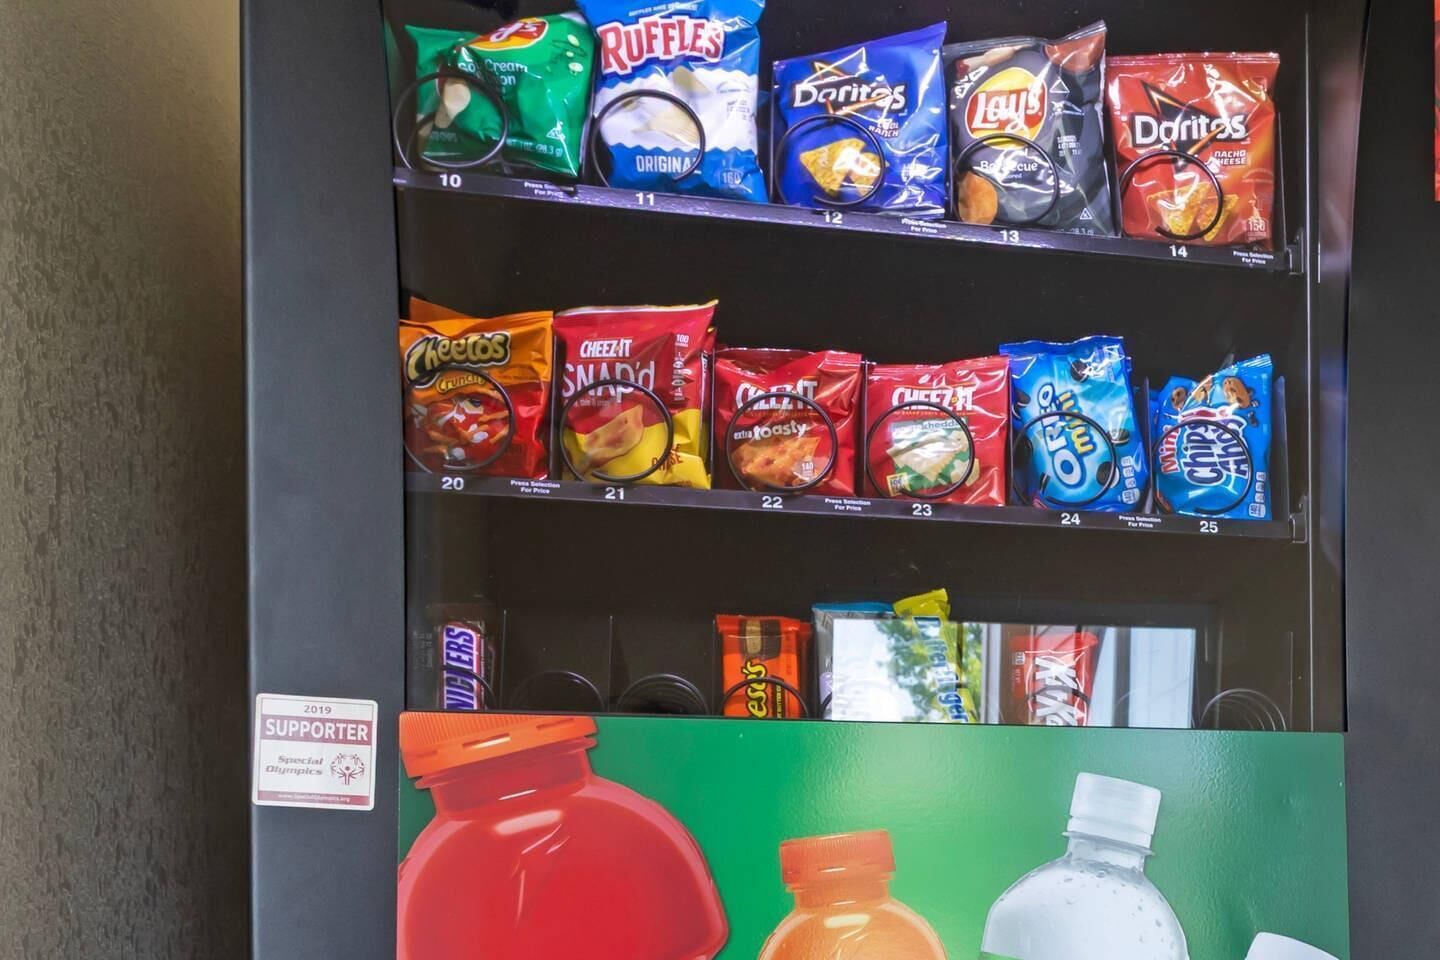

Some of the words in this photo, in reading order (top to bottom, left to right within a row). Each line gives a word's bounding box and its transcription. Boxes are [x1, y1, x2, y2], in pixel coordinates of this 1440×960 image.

[600, 19, 722, 72] RUFFLES
[793, 83, 906, 111] Doritos
[972, 89, 1042, 132] Lay's
[1136, 114, 1247, 145] Doritos
[440, 174, 462, 188] 10
[636, 192, 655, 206] 11
[823, 211, 843, 224] 12
[1000, 230, 1019, 243] 13
[1170, 245, 1188, 258] 14
[406, 332, 510, 384] Cheetos
[753, 420, 808, 440] toasty
[1159, 424, 1181, 474] Mini
[1183, 421, 1225, 485] Chips
[441, 477, 464, 490] 20
[530, 481, 560, 489] Selection
[605, 487, 625, 500] 21
[762, 496, 783, 508] 22
[912, 503, 932, 516] 23
[1061, 512, 1081, 525] 24
[1199, 521, 1219, 533] 25
[304, 705, 332, 714] 2019
[265, 718, 369, 741] SUPPORTER
[278, 755, 324, 765] Special
[265, 765, 323, 776] Olympics
